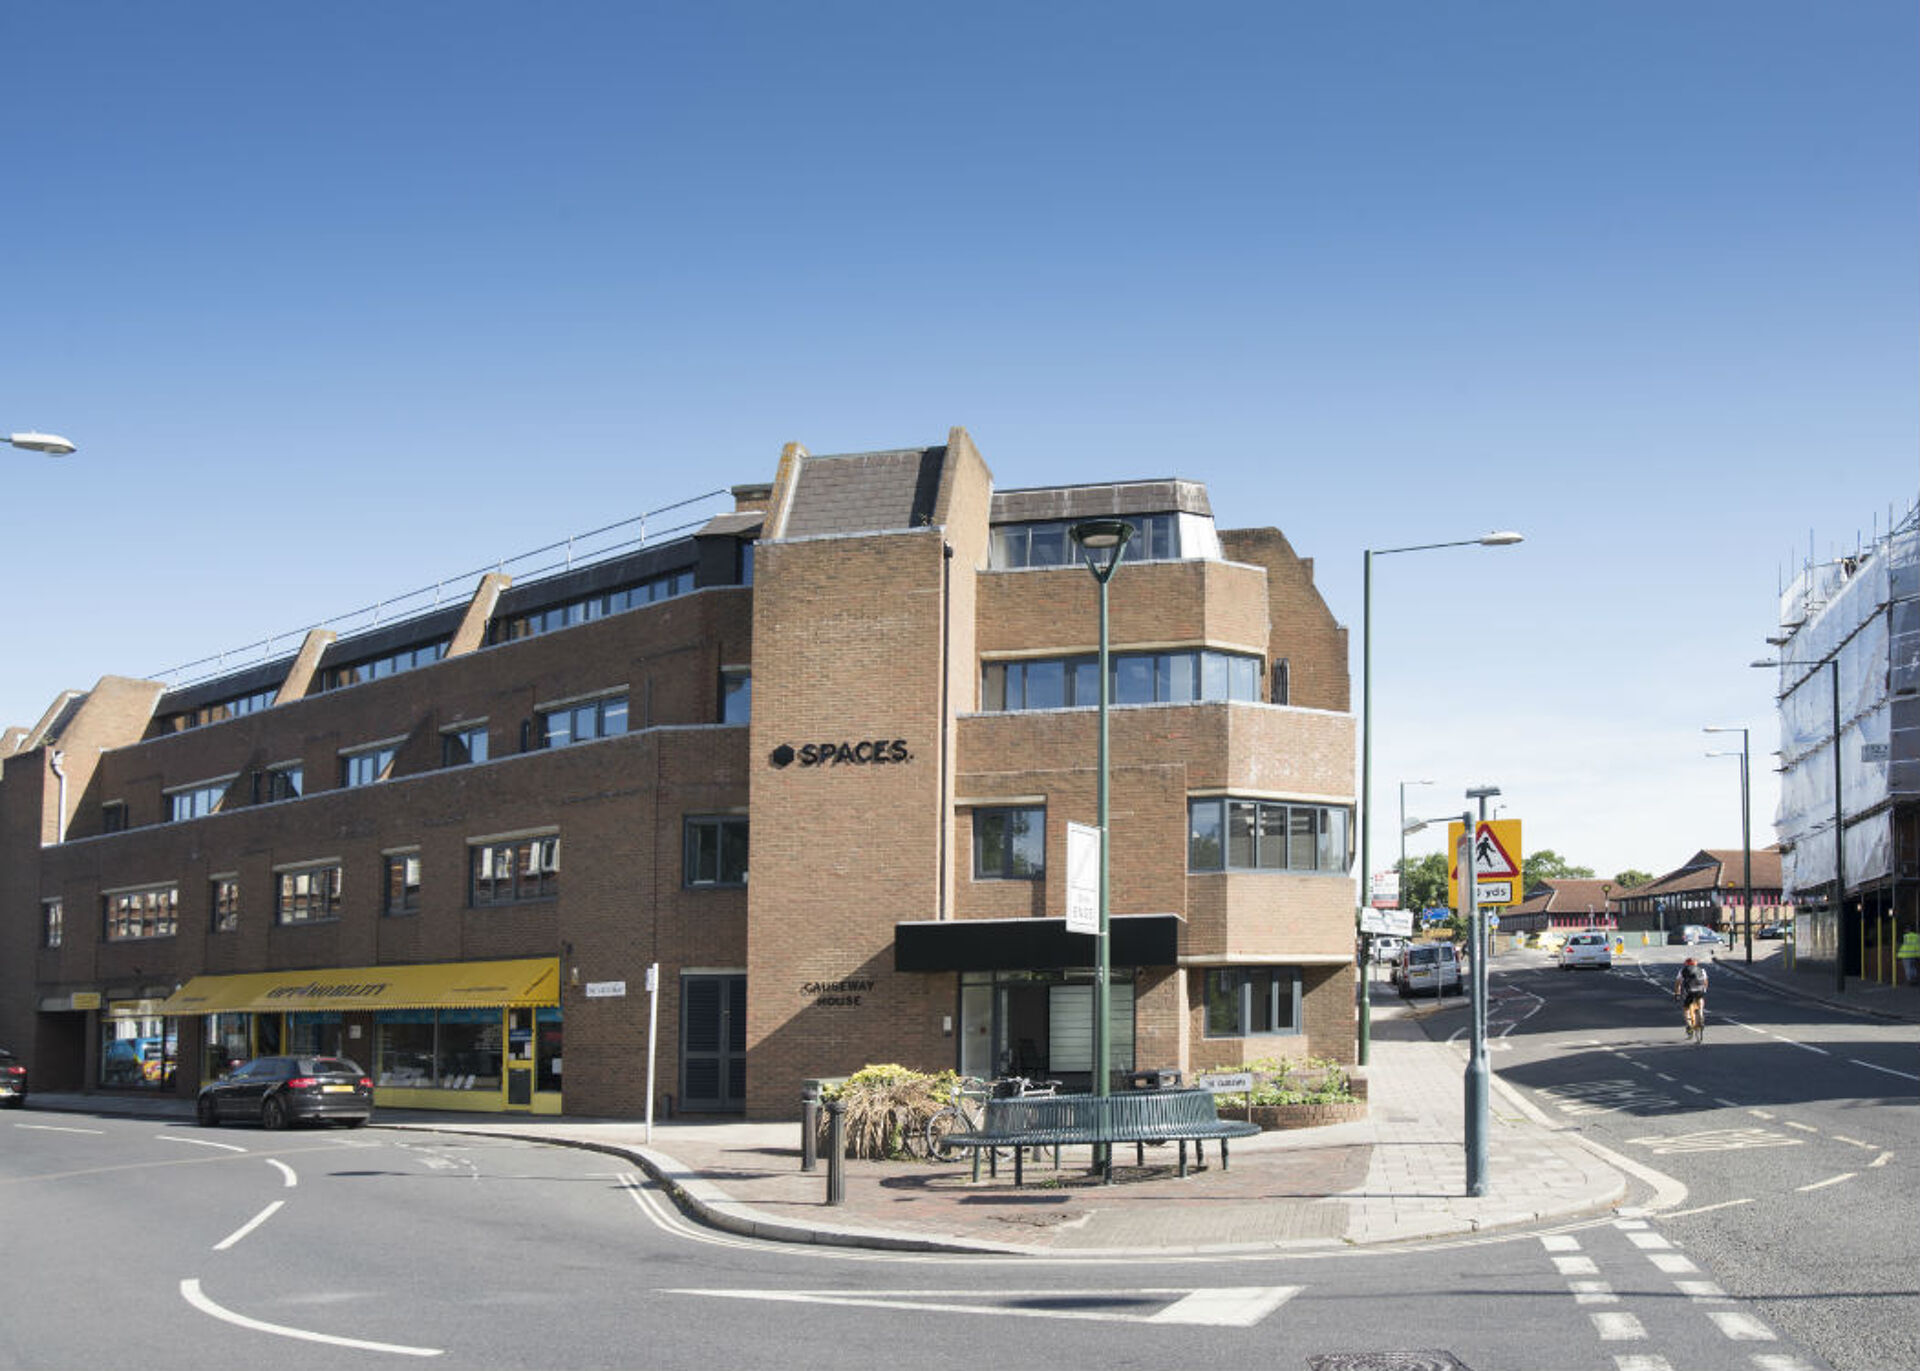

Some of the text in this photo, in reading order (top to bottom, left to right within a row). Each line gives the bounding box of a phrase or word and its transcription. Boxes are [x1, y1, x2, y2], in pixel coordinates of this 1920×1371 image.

[799, 740, 914, 765] SPACES.
[803, 981, 875, 993] CAUSEWAY
[816, 996, 861, 1006] HOUSE
